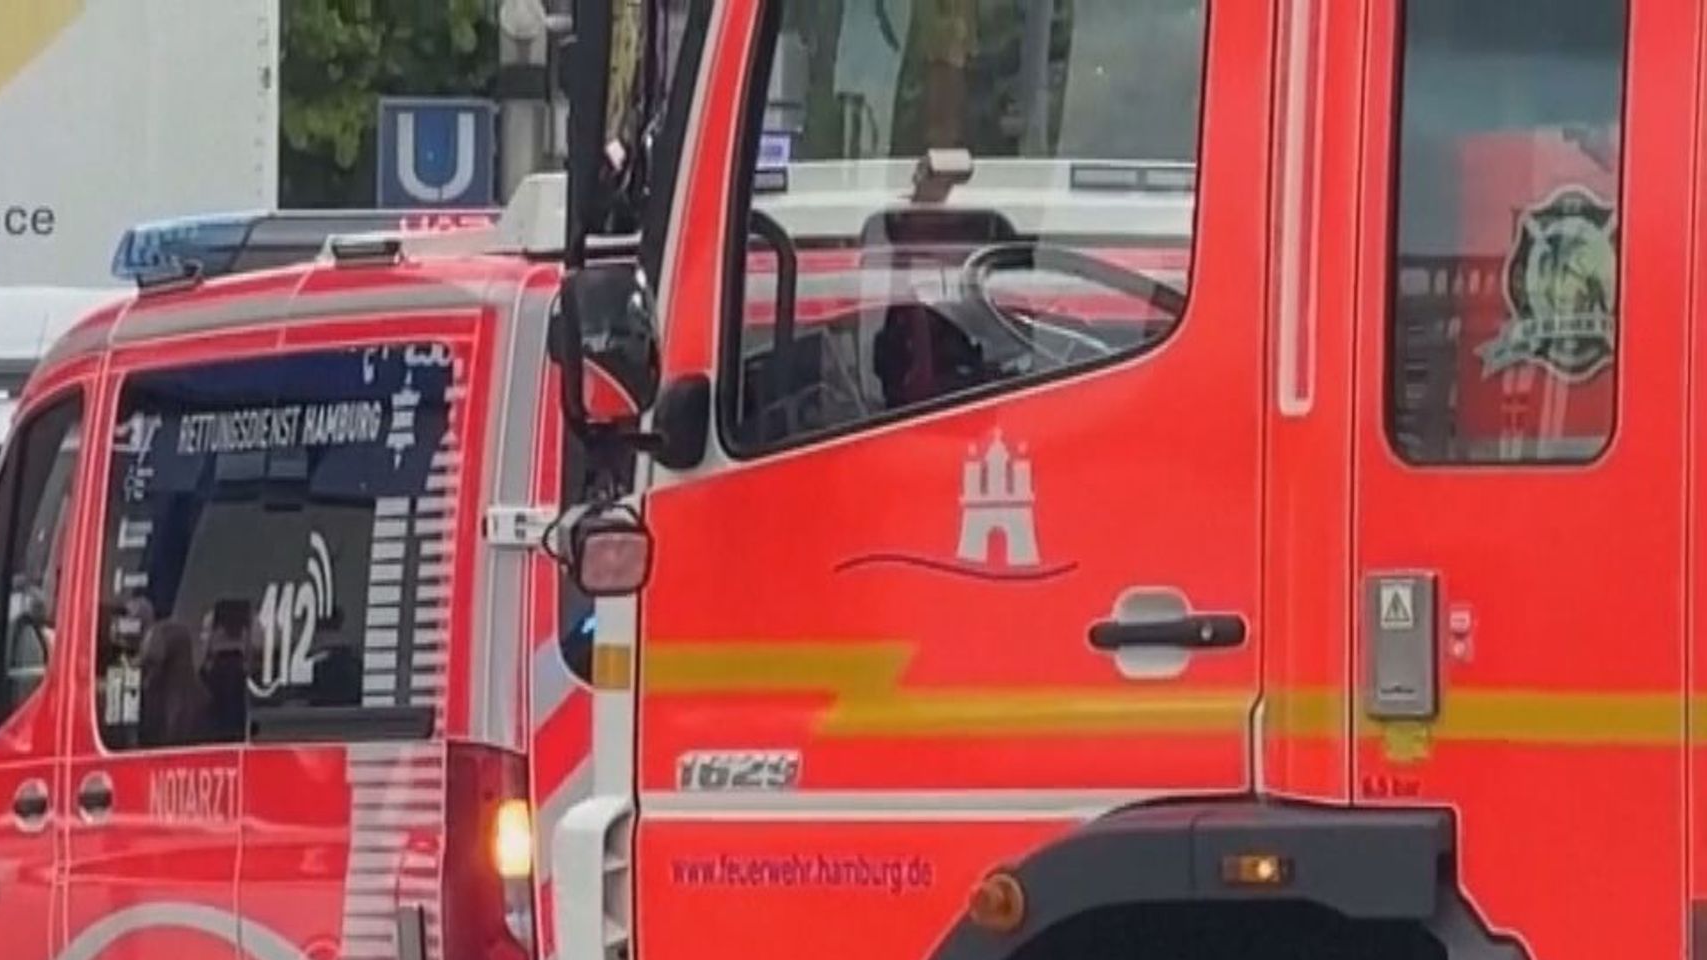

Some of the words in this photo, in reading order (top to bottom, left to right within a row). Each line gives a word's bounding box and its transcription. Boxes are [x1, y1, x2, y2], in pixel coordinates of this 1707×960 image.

[397, 112, 475, 201] U
[176, 406, 301, 453] RETTUNGSDIENST
[302, 401, 382, 445] HAMBURG
[258, 582, 316, 686] 112
[150, 767, 239, 825] NOTARZT
[671, 854, 933, 893] www.feuerwehr.hamburg.de
